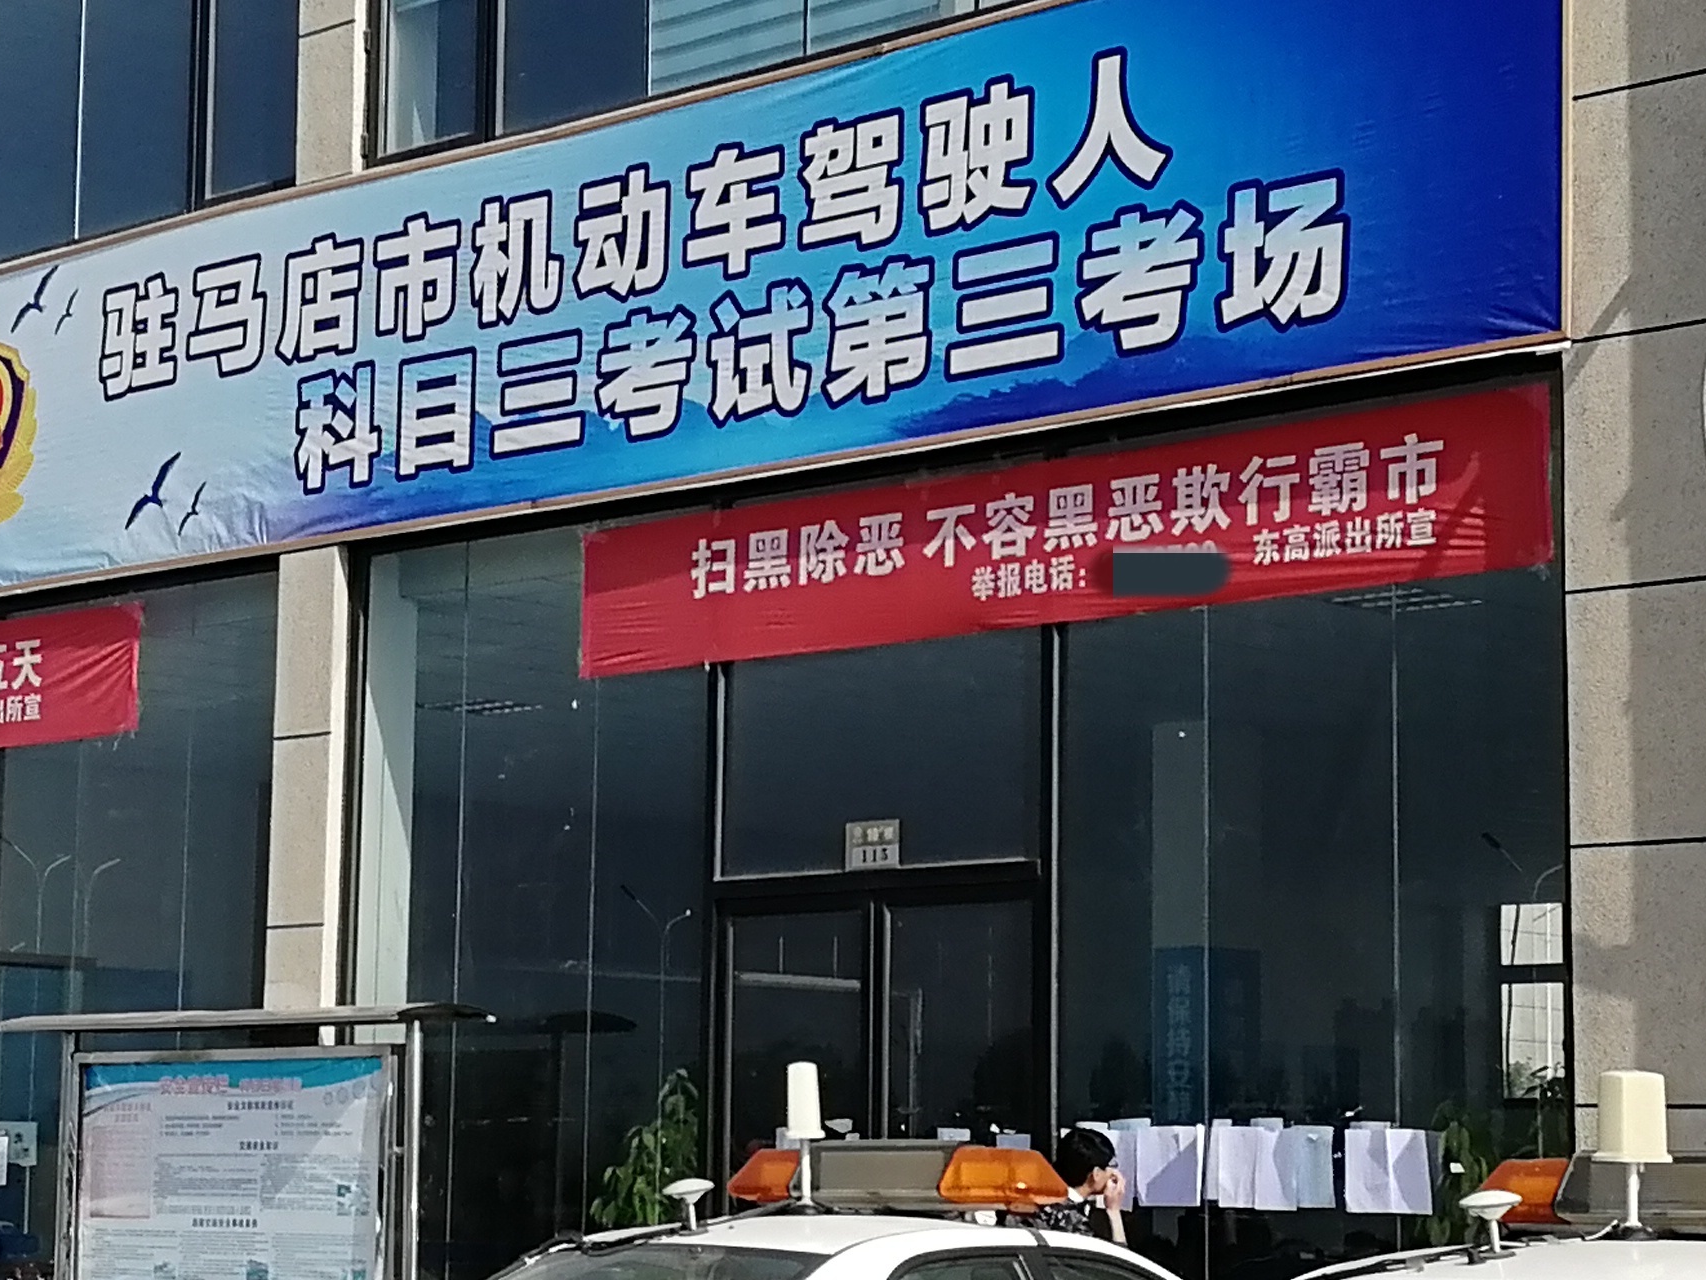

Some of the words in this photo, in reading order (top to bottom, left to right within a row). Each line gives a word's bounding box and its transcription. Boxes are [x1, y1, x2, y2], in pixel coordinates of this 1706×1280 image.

[99, 46, 1173, 402] 驻马店市机动车驾驶人
[295, 171, 1350, 494] 科目三考试第三考场
[691, 510, 905, 598] 扫黑除恶
[923, 433, 1445, 566] 不容黑恶欺行霸市
[1252, 508, 1438, 567] 东高派出所宣
